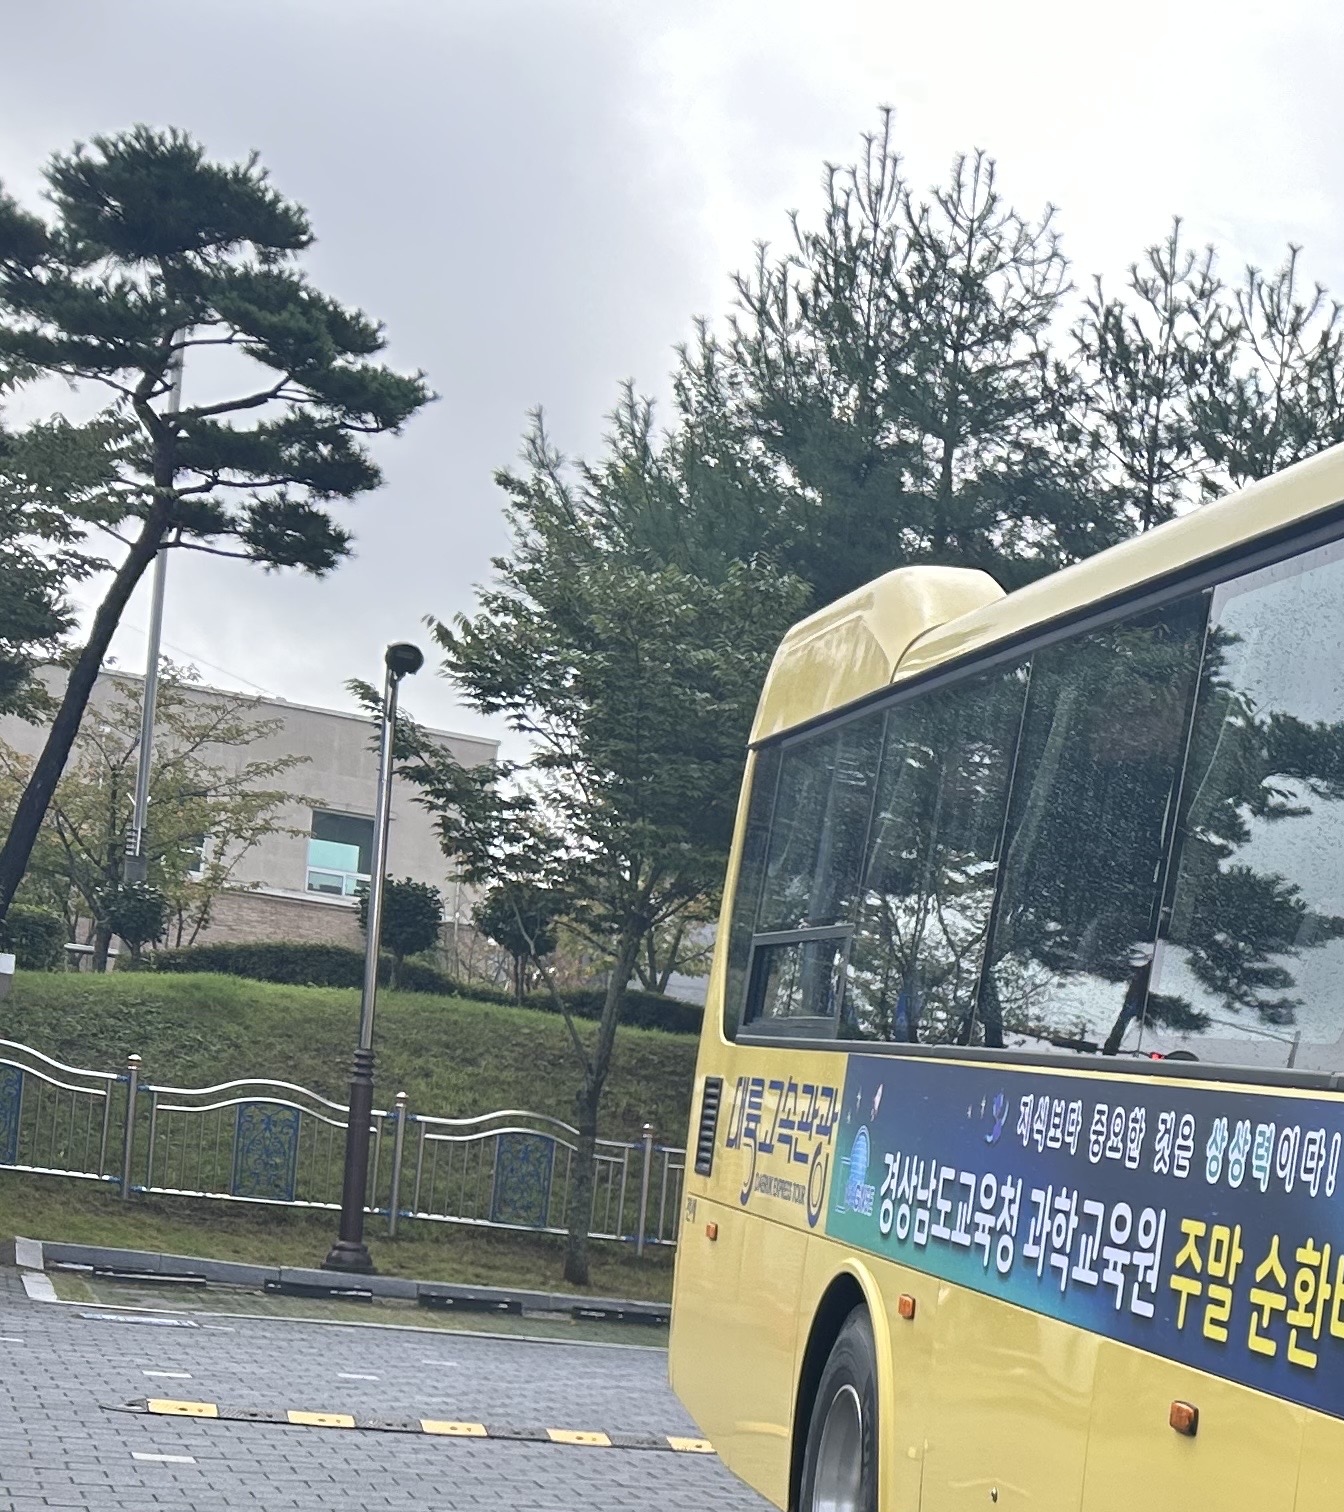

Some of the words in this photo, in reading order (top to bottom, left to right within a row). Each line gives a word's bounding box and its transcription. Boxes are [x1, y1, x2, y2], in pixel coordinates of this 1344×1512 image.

[1016, 1093, 1082, 1156] 지식보다
[1089, 1103, 1146, 1169] 중요한
[1153, 1110, 1195, 1178] 것은
[1206, 1117, 1341, 1197] 상상력이다!
[879, 1151, 1023, 1274] 경상남도교육청
[1023, 1184, 1167, 1318] 과학교육원
[1169, 1218, 1243, 1343] 주말
